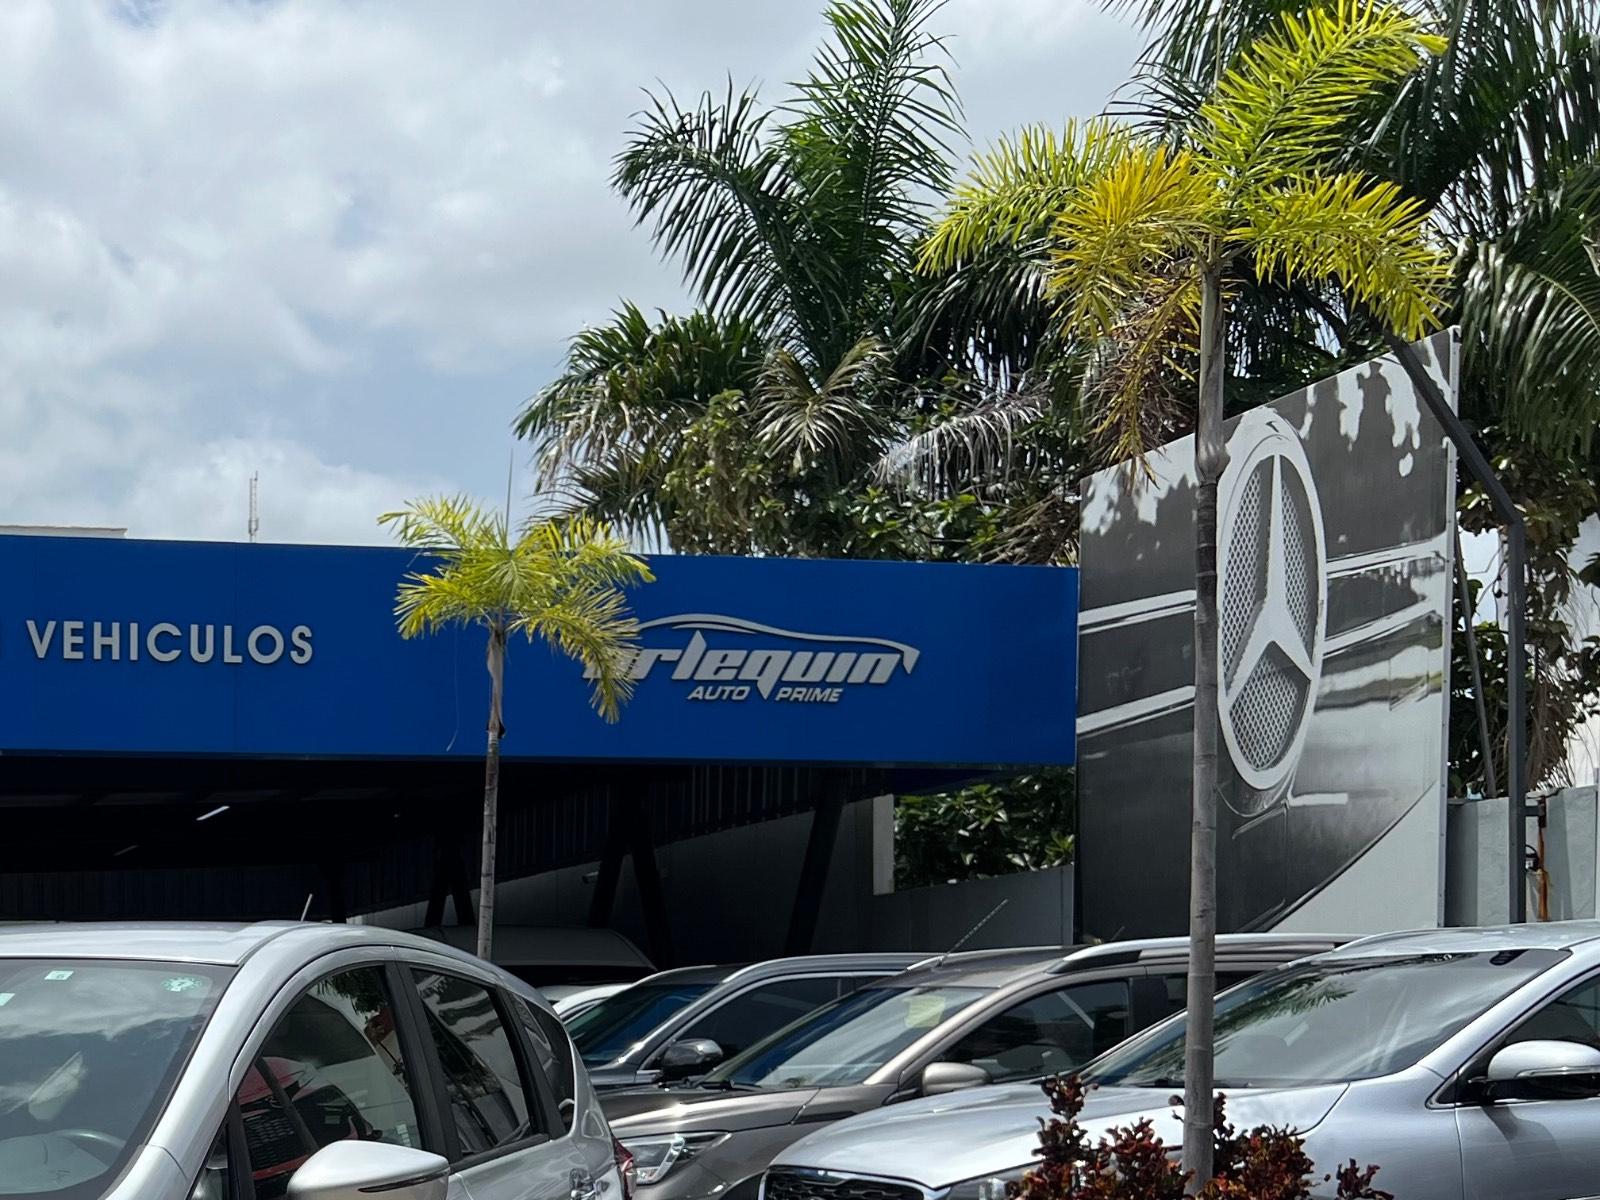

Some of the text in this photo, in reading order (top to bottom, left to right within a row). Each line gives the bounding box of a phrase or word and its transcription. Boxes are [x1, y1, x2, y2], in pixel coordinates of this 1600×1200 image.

[26, 620, 313, 664] VEHICULOS
[582, 630, 901, 700] rlequin
[687, 685, 843, 702] AUTO PRIME
